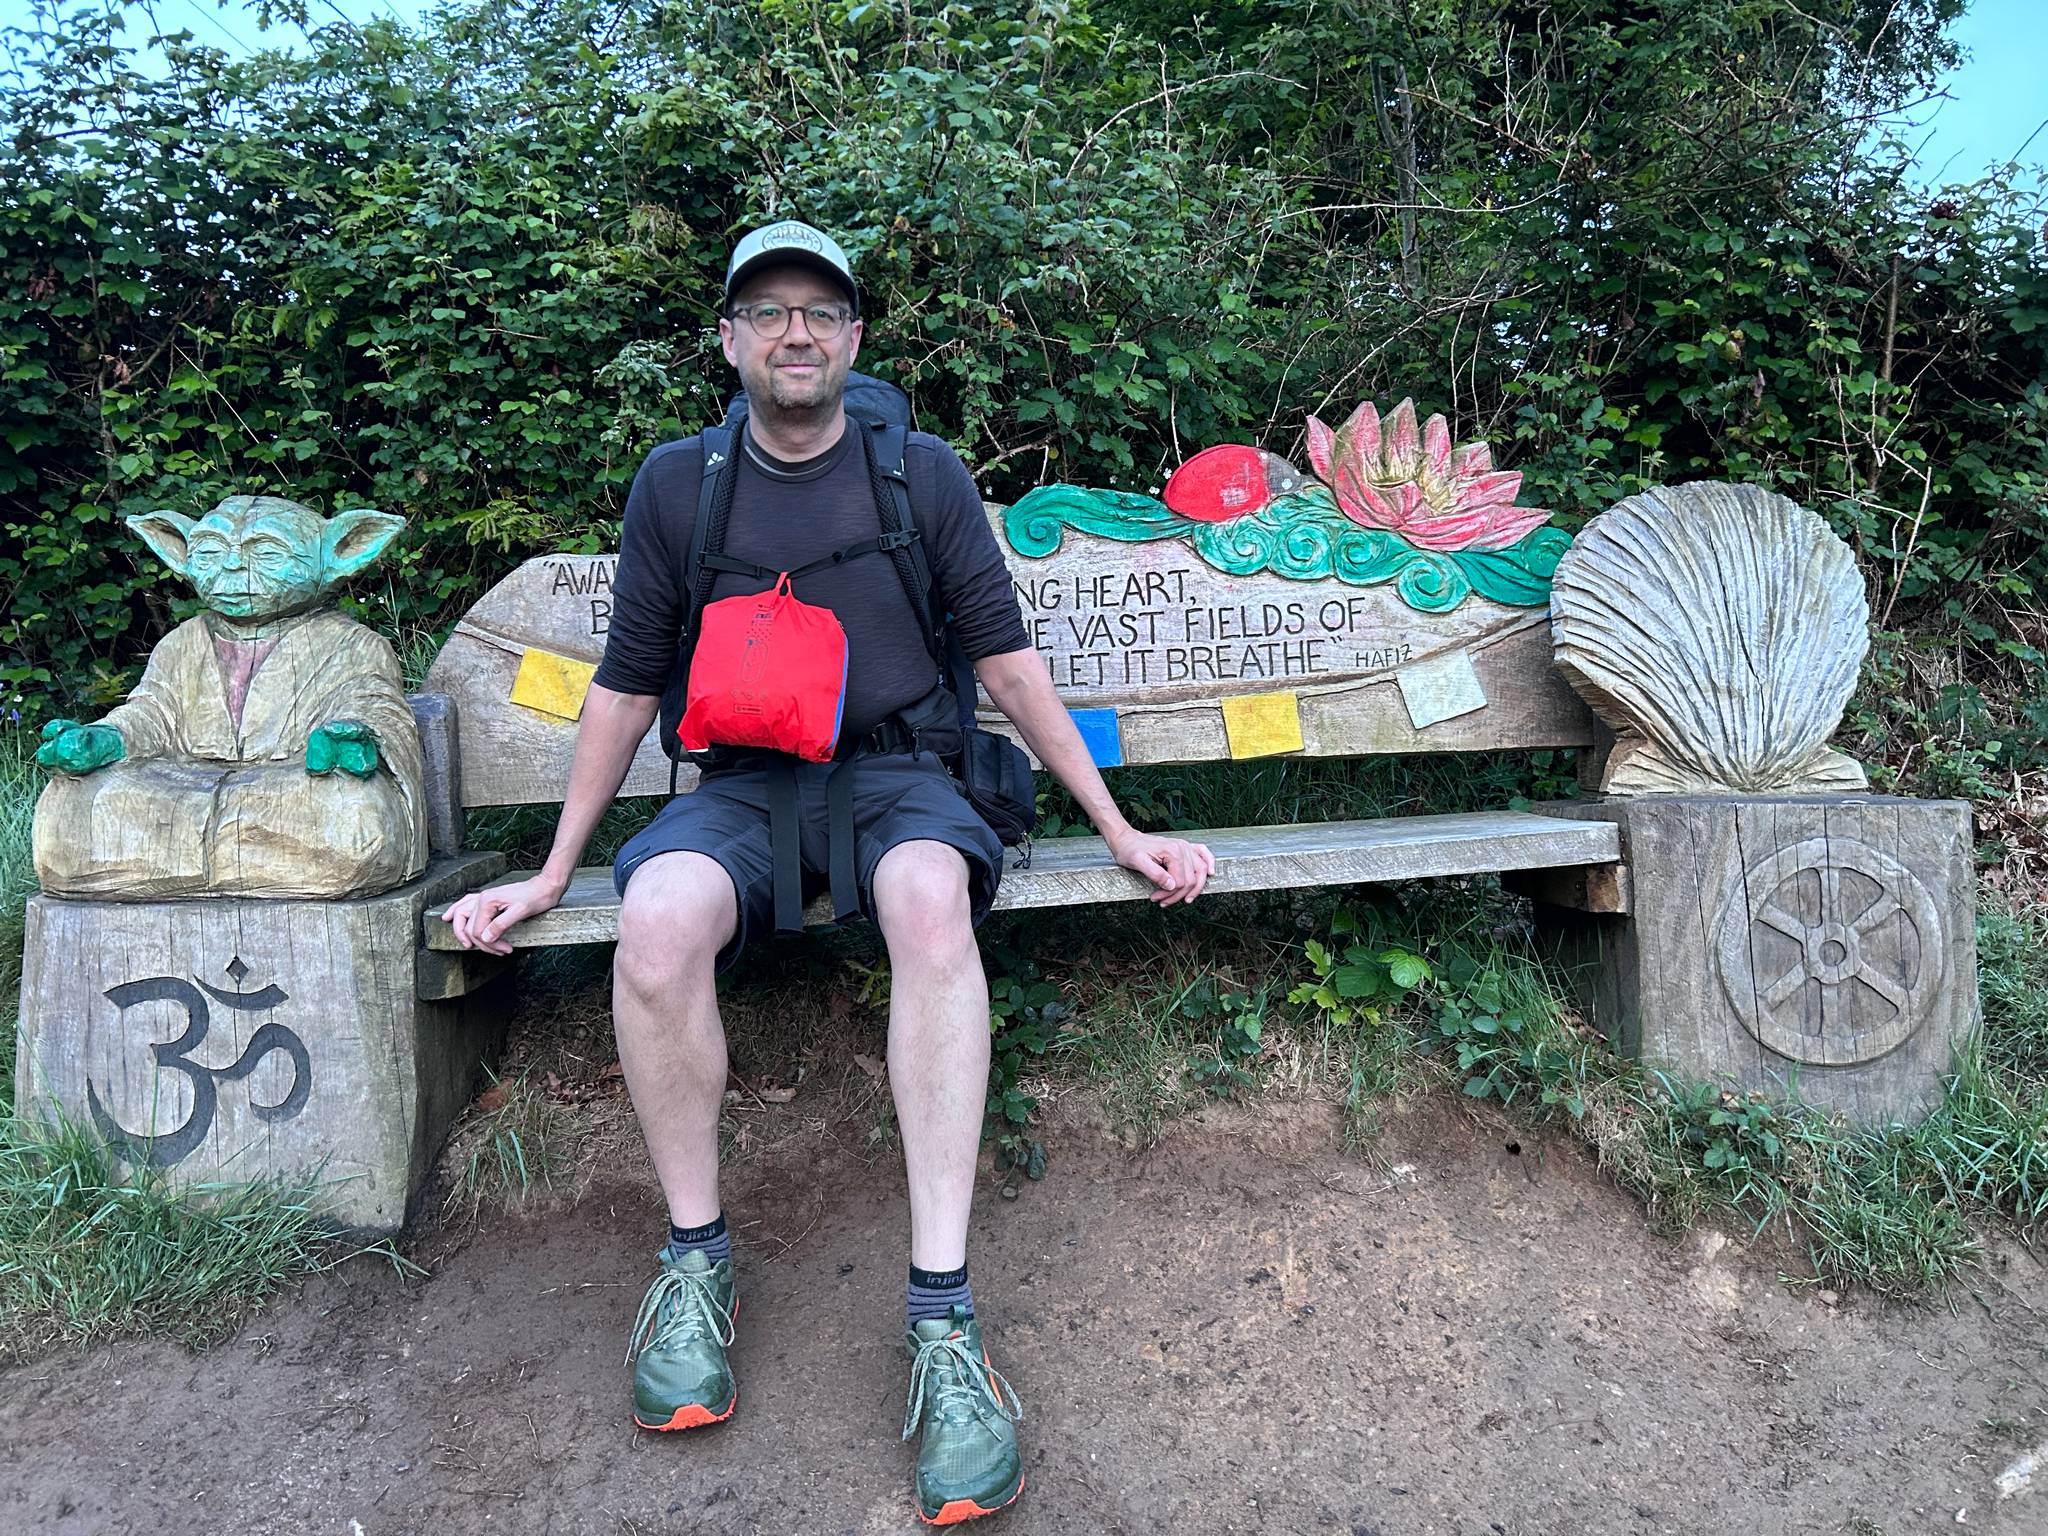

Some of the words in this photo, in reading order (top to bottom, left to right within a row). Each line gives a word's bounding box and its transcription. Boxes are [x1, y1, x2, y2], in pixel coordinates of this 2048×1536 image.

[1013, 579, 1062, 612] NG
[1075, 569, 1197, 610] HEART,
[1067, 610, 1165, 650] VAST
[1185, 602, 1305, 643] FIELDS
[1318, 597, 1366, 633] OF
[1123, 648, 1154, 685] IT
[1355, 643, 1413, 668] HAFIZ
